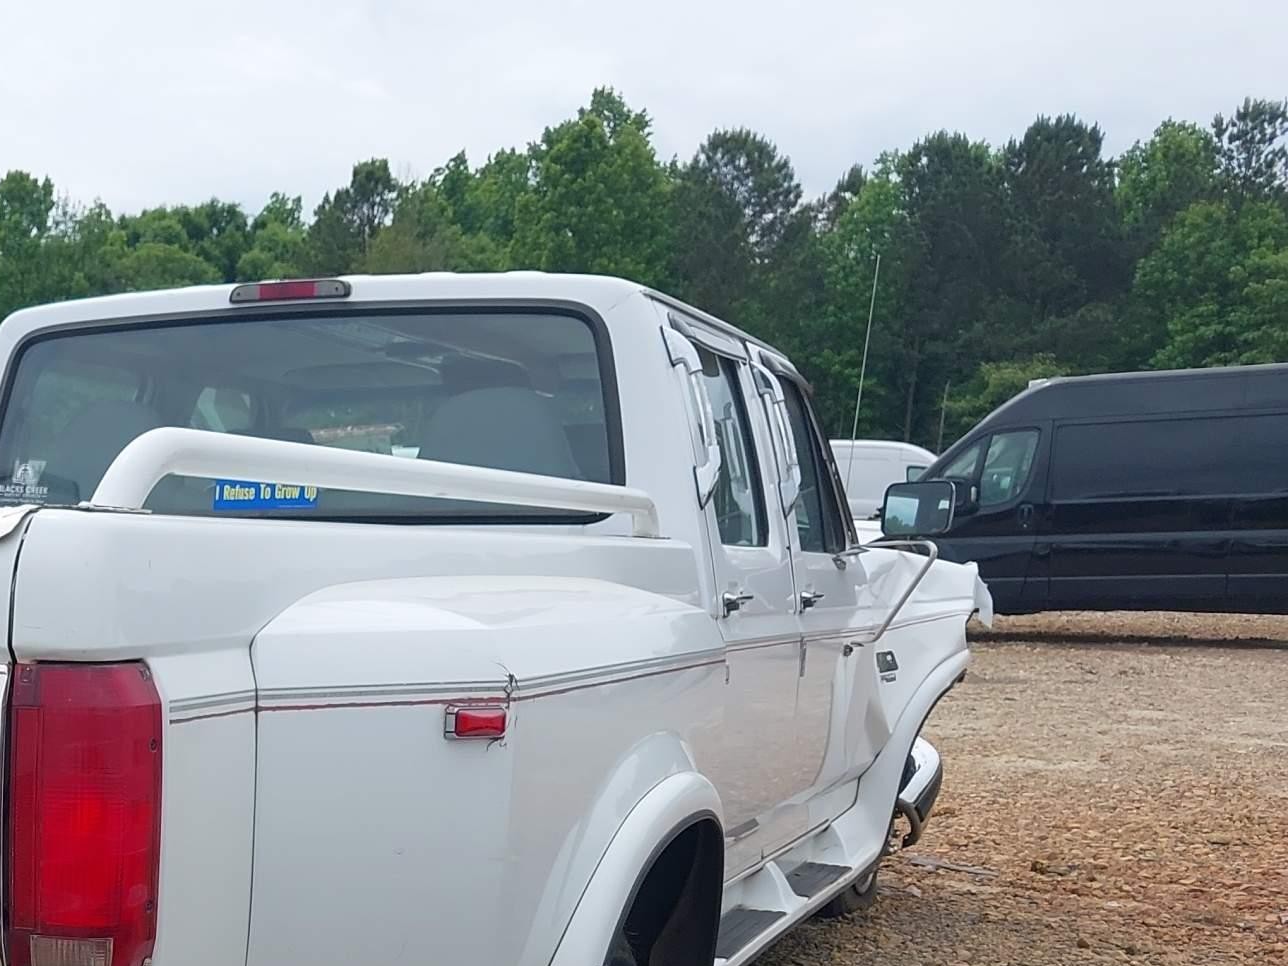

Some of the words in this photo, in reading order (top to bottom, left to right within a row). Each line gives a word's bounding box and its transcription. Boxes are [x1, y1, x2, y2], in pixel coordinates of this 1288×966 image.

[223, 484, 256, 501] Refuse
[259, 484, 272, 500] To
[274, 484, 301, 500] Grow
[304, 485, 318, 502] Up
